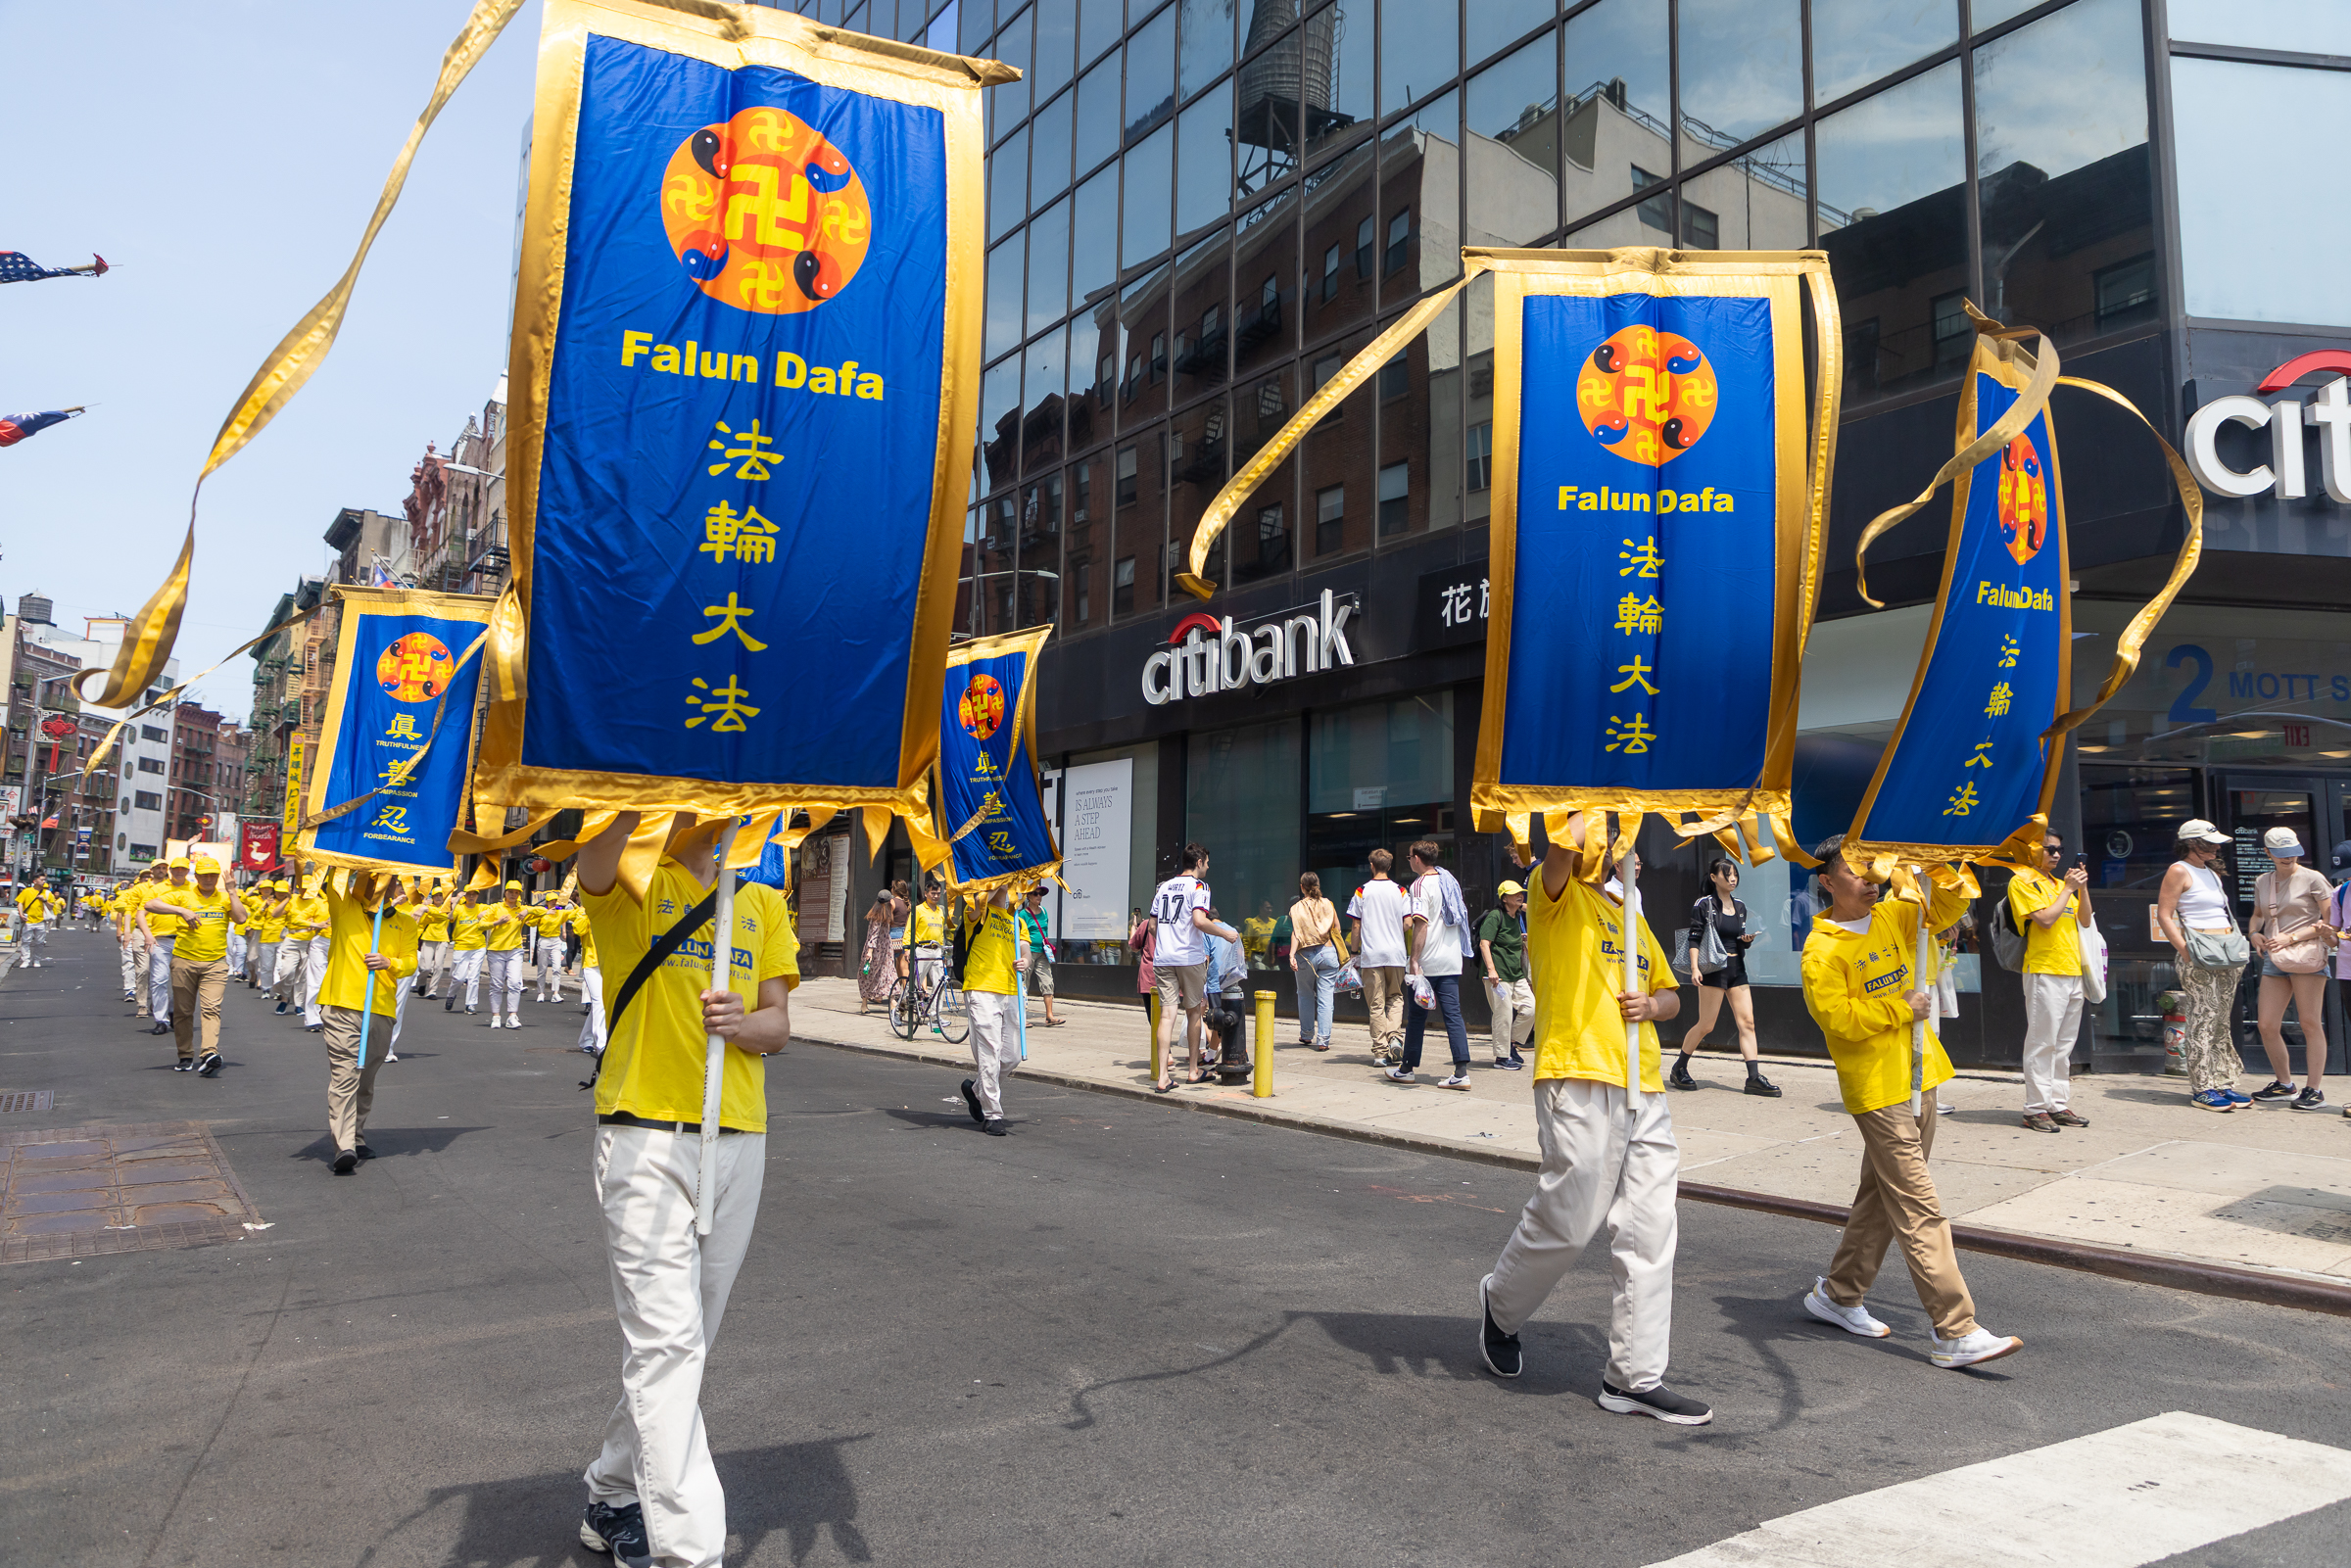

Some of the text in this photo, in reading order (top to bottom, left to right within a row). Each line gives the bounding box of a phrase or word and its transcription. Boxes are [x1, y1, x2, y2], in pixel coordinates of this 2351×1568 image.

[621, 330, 884, 401] Falun Dafa
[1559, 486, 1734, 515] Falun Dafa
[685, 418, 785, 733] 法輪大法
[1977, 581, 2053, 611] Falun Dafa
[1142, 589, 1354, 705] citibank
[1606, 536, 1665, 754] 法輪大法
[2166, 643, 2351, 724] 2 MOTT S
[1943, 634, 2021, 816] 法輪大法
[376, 739, 425, 751] TRUTHFULNES
[1076, 795, 1113, 811] IS ALWAYS
[371, 805, 410, 833] 忍
[980, 816, 1013, 825] OMPASSION
[1075, 812, 1100, 826] A STEP
[363, 832, 415, 845] FORBEARANCE
[987, 832, 1016, 853] 忍
[1075, 827, 1101, 840] AHEAD
[1159, 894, 1184, 924] 17
[1866, 974, 1894, 992] FALUN
